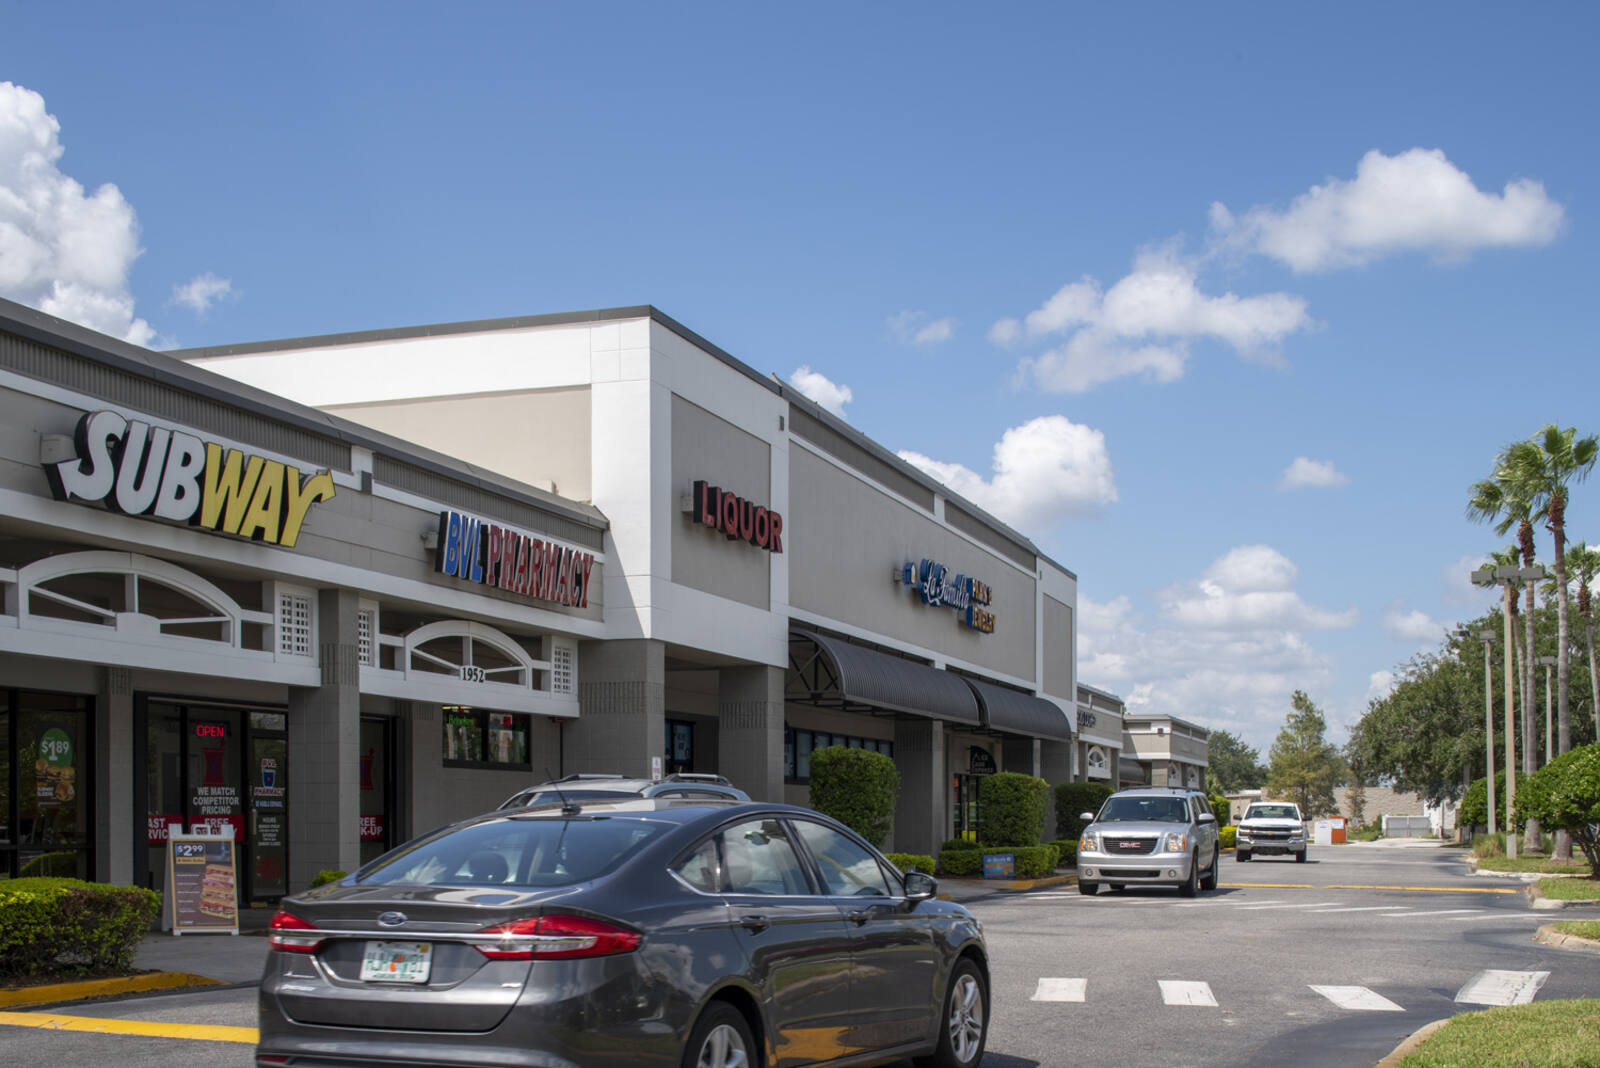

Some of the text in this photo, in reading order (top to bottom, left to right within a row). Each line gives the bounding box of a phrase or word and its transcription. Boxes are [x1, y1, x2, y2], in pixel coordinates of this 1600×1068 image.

[57, 409, 336, 548] SUBWAY
[700, 480, 783, 553] LIQUOR
[441, 510, 594, 608] BVL PHARMACY
[462, 667, 484, 683] 1952
[196, 725, 224, 737] OPEN
[197, 787, 236, 796] WE MATCH
[192, 797, 240, 806] COMPETITOR
[201, 806, 232, 815] PRICING
[147, 818, 166, 828] AST
[359, 817, 376, 826] REE
[147, 829, 168, 840] RVIC
[360, 826, 383, 836] K-UP
